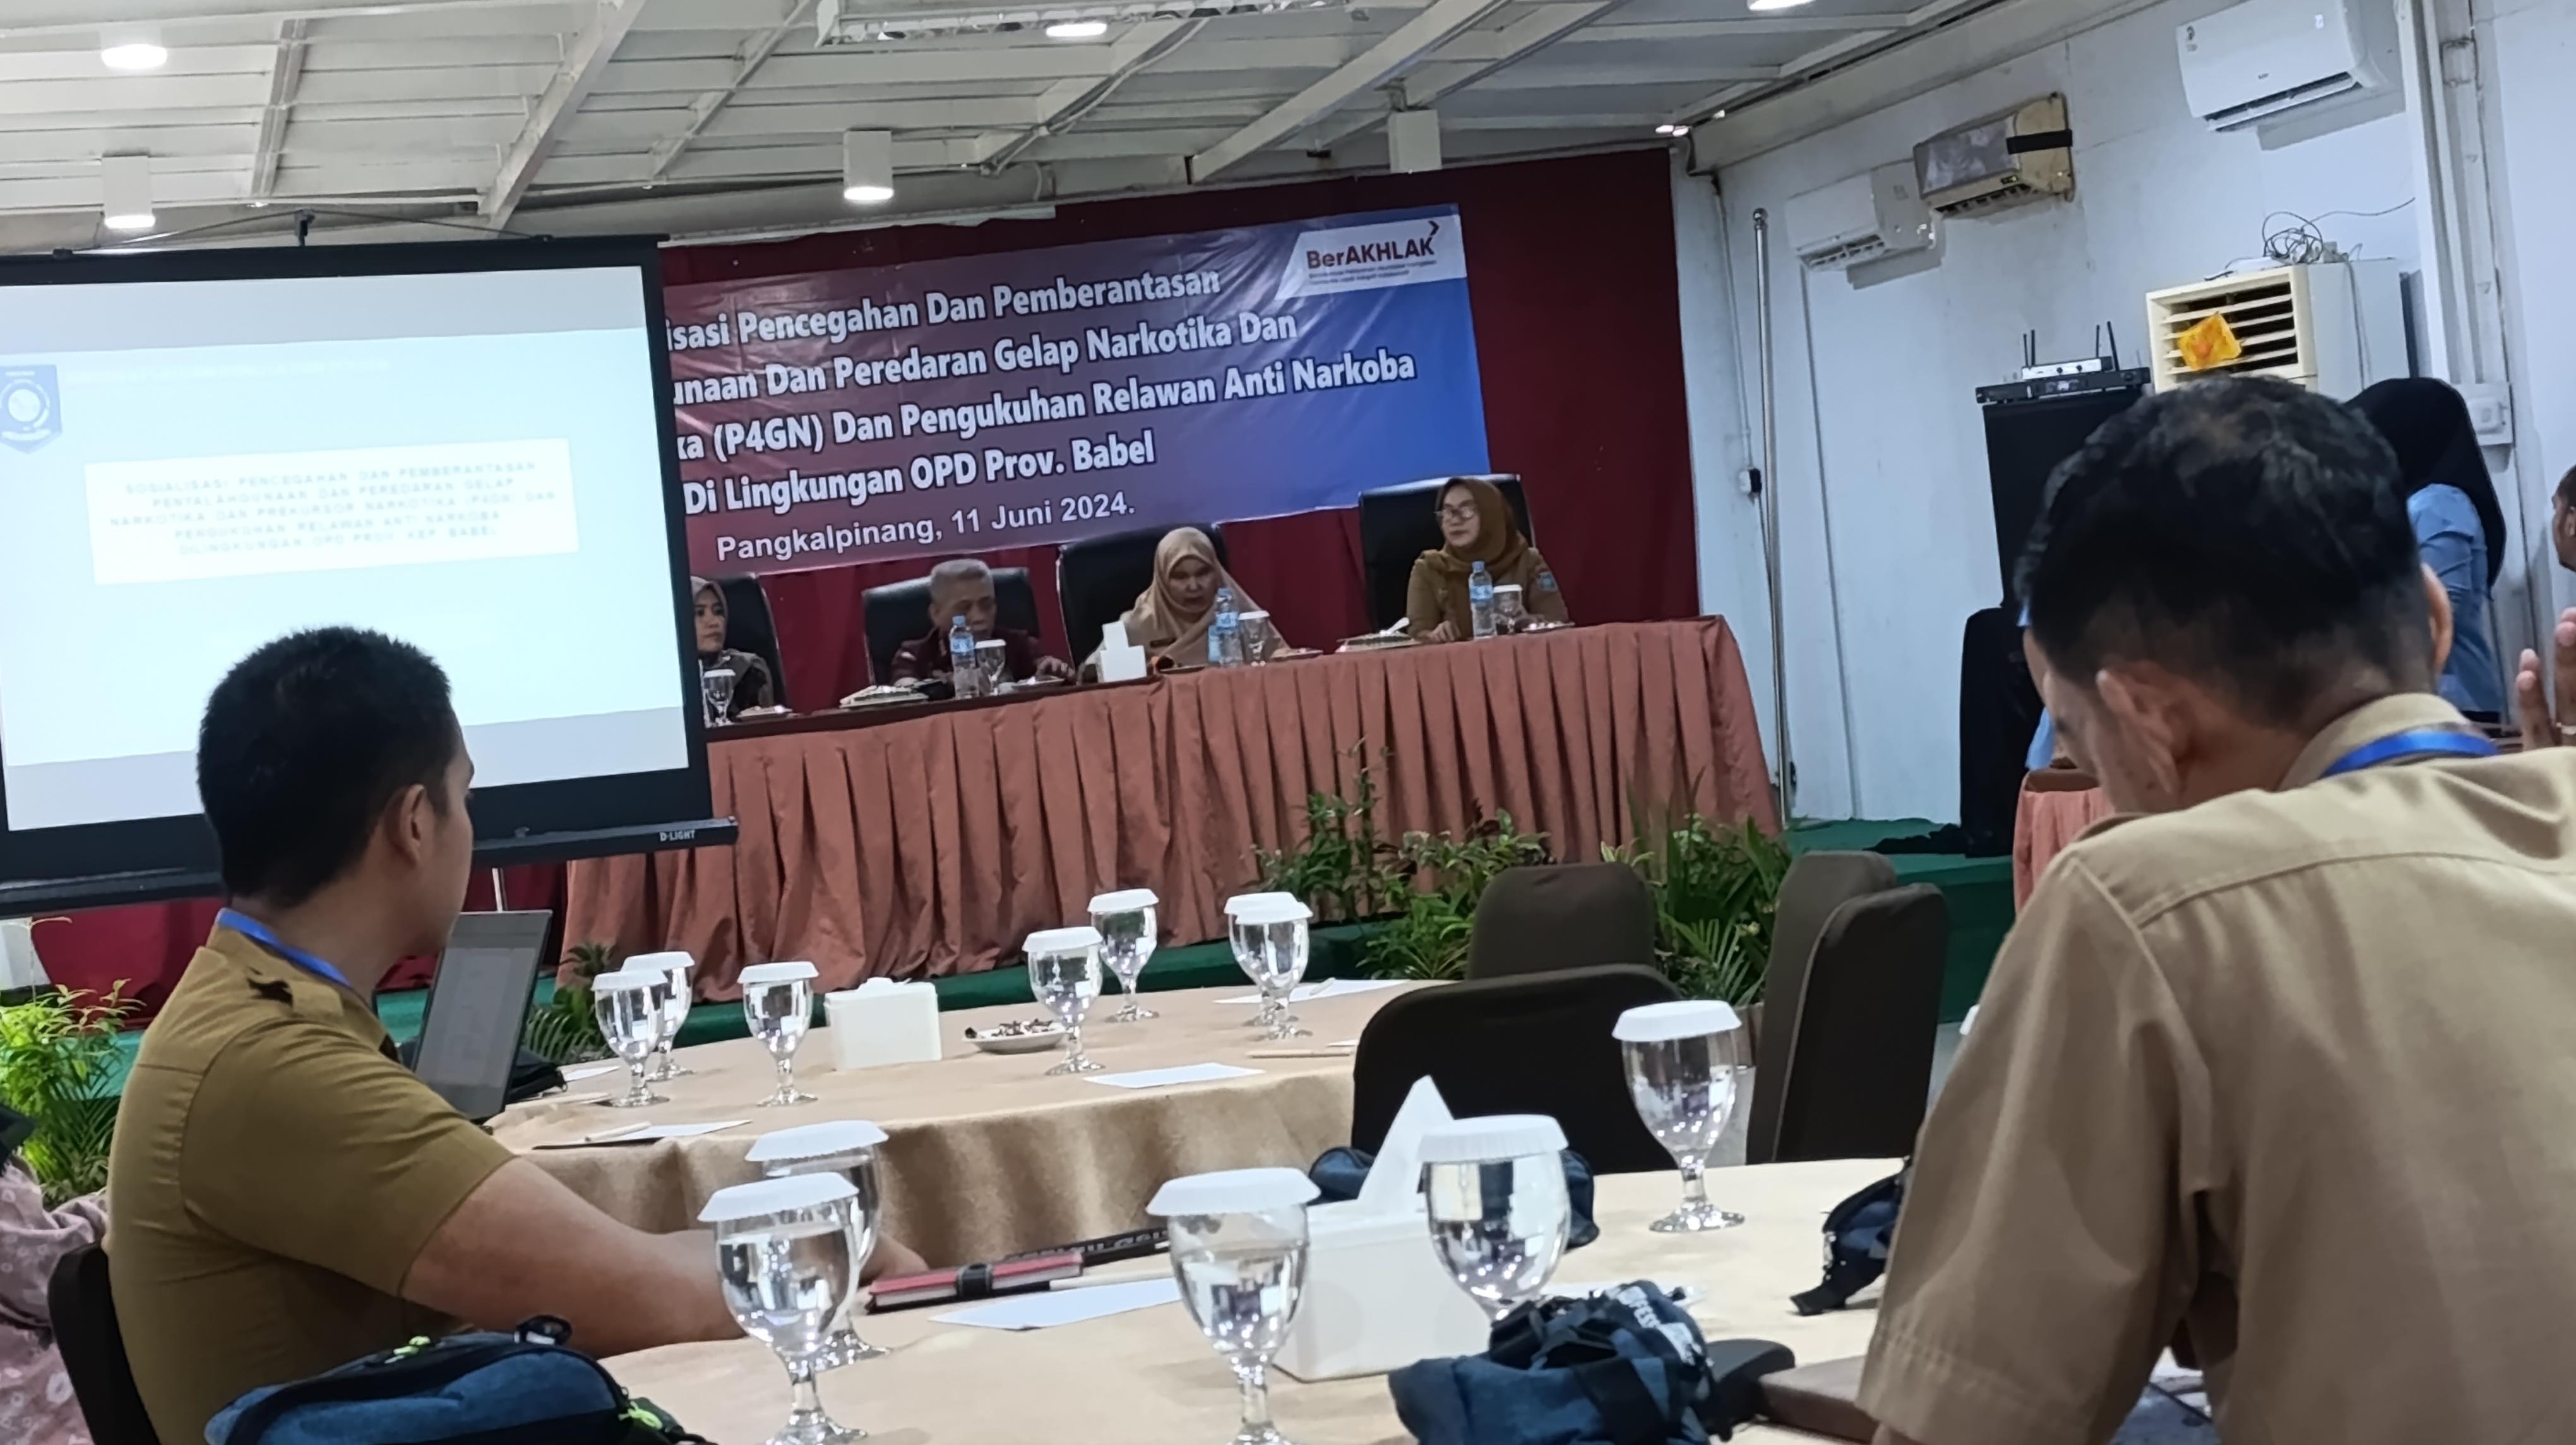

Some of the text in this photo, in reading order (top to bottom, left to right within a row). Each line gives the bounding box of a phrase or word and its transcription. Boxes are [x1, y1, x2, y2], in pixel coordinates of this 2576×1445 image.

[1306, 237, 1434, 269] BerAKHLAK
[738, 299, 919, 344] Pencegahan
[927, 292, 985, 323] Dan
[993, 271, 1220, 316] Pemberantasan
[765, 363, 827, 395] Dan
[833, 347, 987, 388] Peredaran
[994, 335, 1078, 373] Gelap
[1087, 316, 1232, 360] Narkotika
[1238, 311, 1298, 344] Dan
[714, 414, 823, 462] (P4GN)
[833, 411, 893, 443] Dan
[900, 389, 1085, 439] Pengukuhan
[1093, 378, 1215, 414] Relawan
[1224, 361, 1285, 399] Anti
[1292, 349, 1415, 390] Narkoba
[683, 429, 1154, 515] Di Lingkungan OPD Prov. Babel
[717, 491, 1135, 561] Pangkalpinang, 11 Juni 2024.
